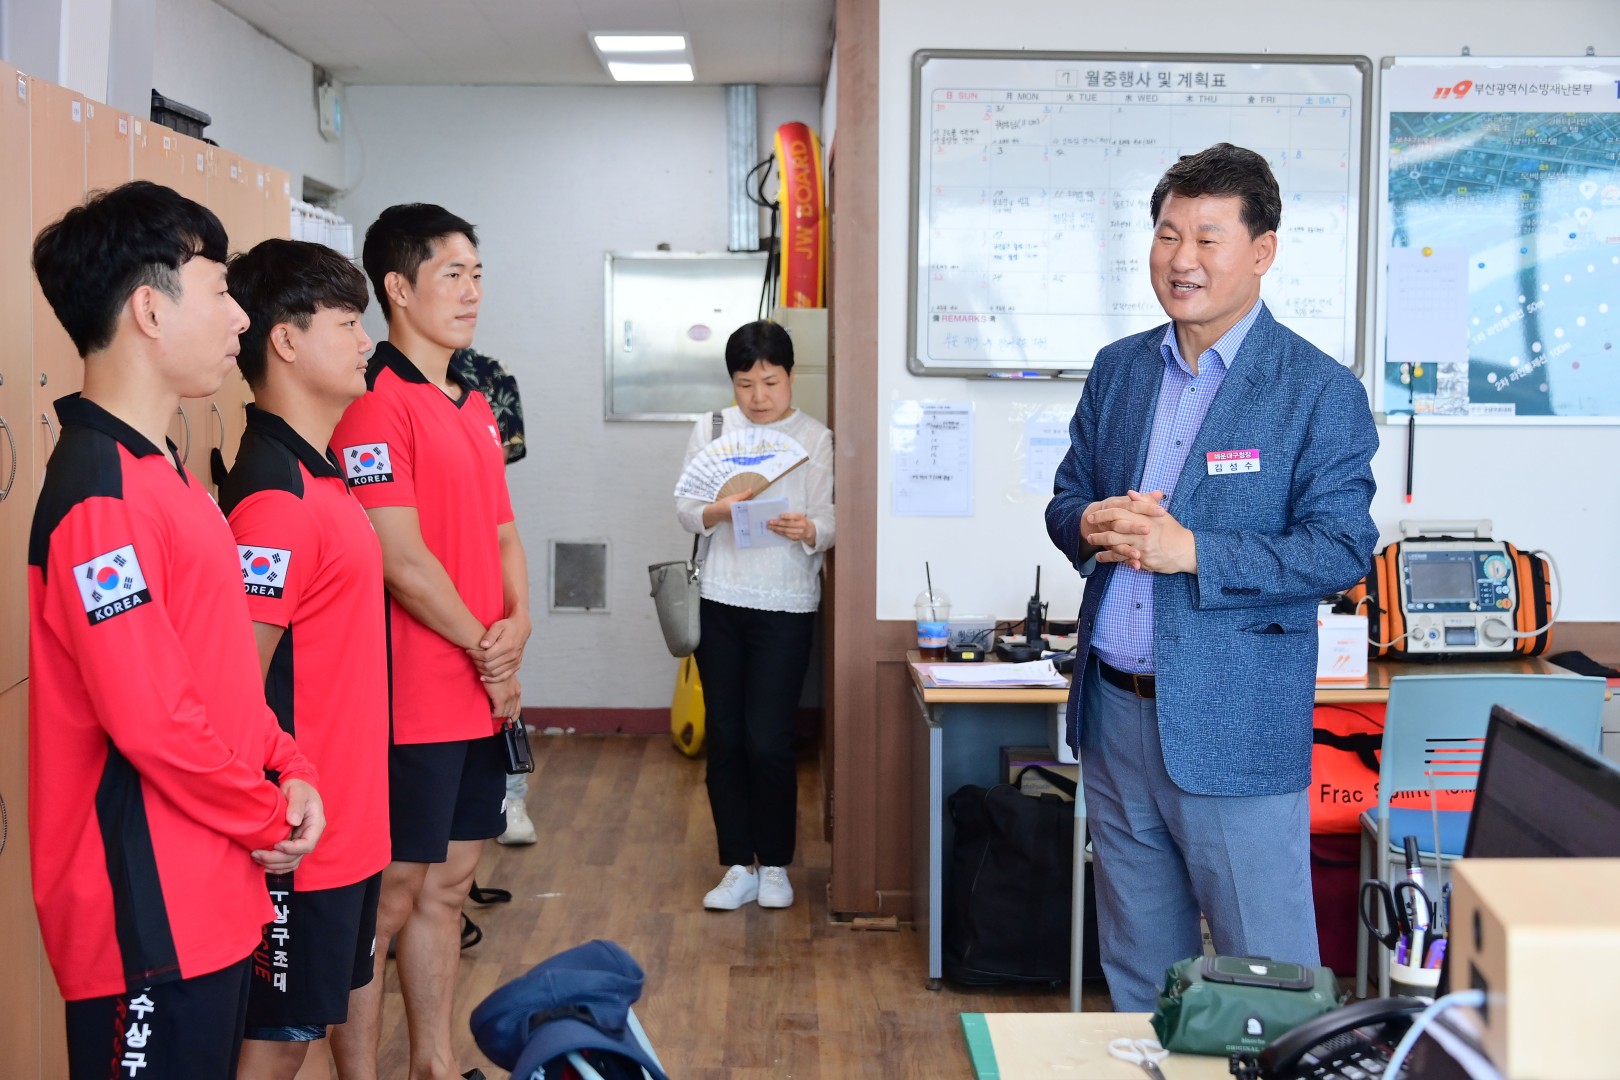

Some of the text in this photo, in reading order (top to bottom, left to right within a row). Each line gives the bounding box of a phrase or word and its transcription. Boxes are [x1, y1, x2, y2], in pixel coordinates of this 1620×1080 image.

[1085, 70, 1227, 88] 월중행사 및 계획표
[1432, 80, 1593, 99] 119 부산광역시소방재난본부
[958, 91, 978, 100] SUN
[1018, 92, 1039, 101] MON
[1080, 93, 1097, 102] TUE
[1138, 95, 1158, 103] WED
[1199, 95, 1217, 104] THU
[1260, 96, 1275, 104] FRI
[1318, 97, 1337, 105] SAT
[942, 314, 987, 323] REMARKS
[354, 474, 388, 486] KOREA
[245, 584, 275, 596] OREA
[95, 594, 143, 621] KOREA
[1320, 784, 1363, 804] Frac
